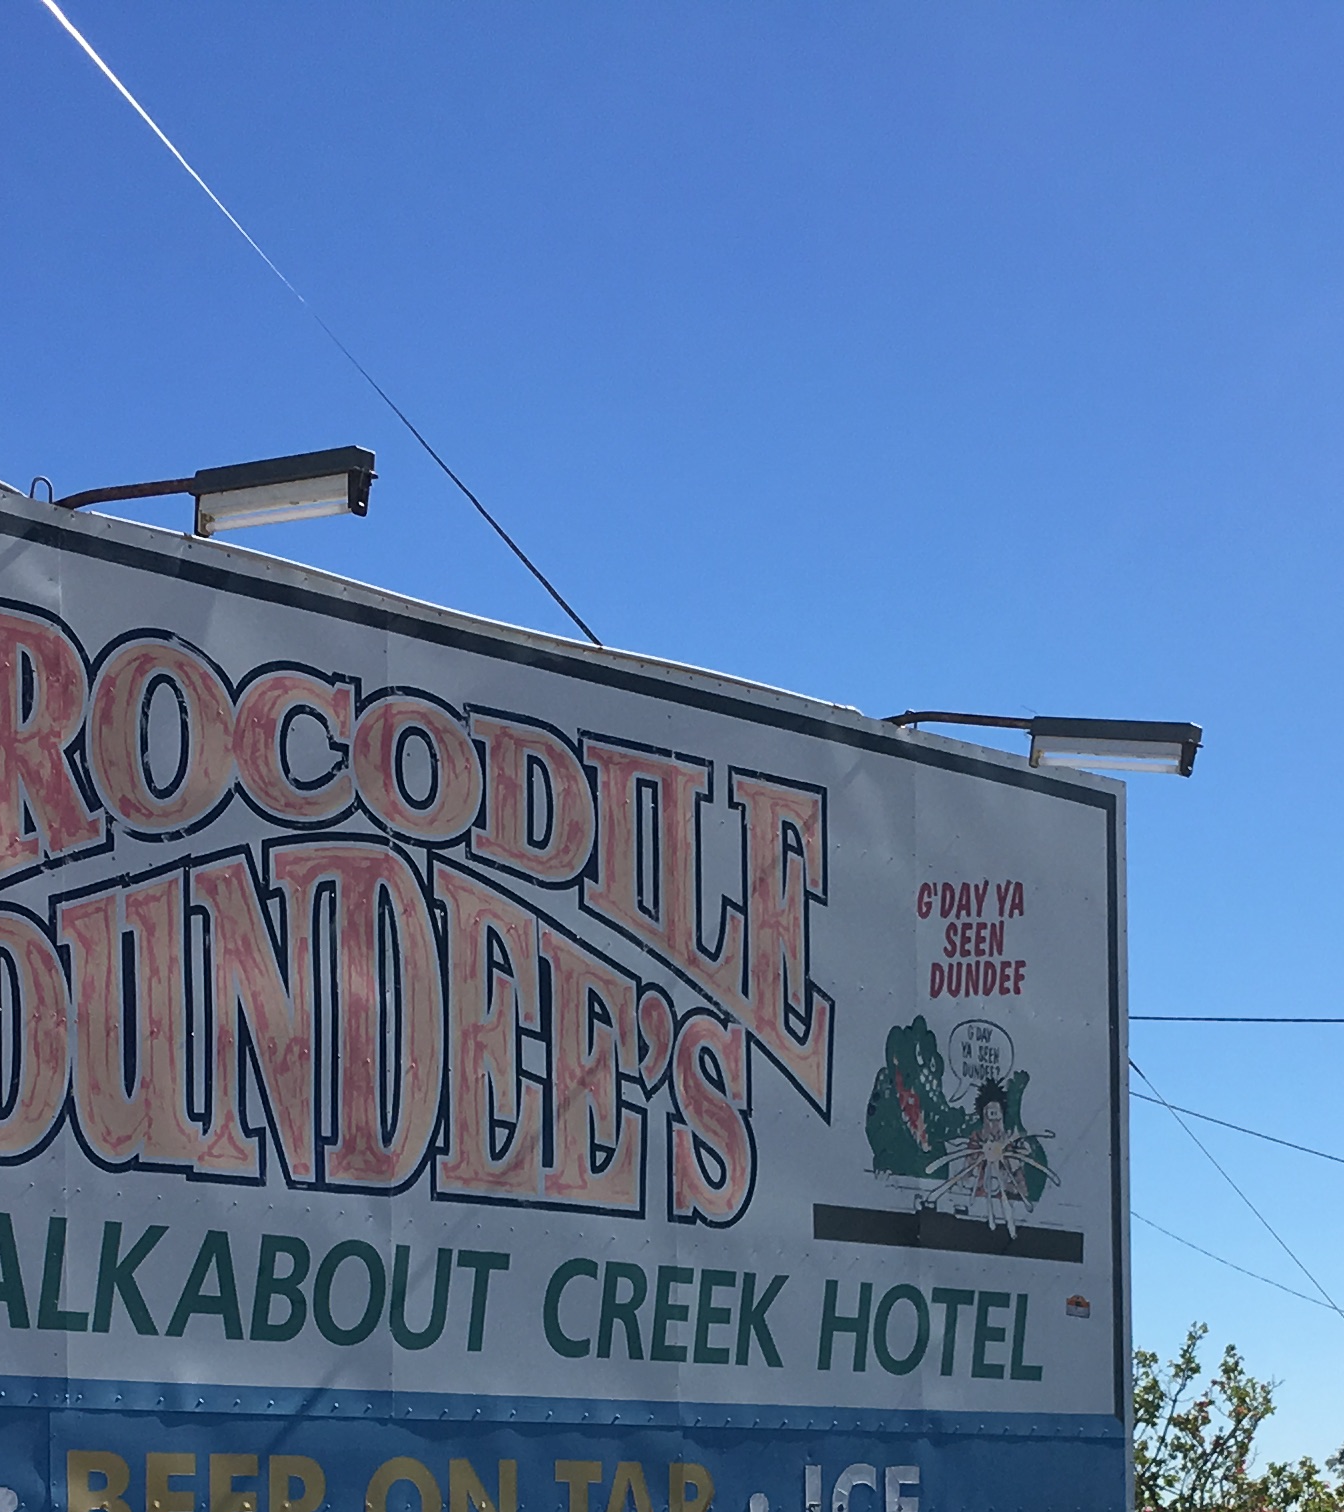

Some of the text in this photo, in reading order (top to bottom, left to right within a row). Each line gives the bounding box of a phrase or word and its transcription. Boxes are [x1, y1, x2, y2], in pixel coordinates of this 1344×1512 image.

[917, 879, 1024, 920] G'DAY YA
[943, 920, 1005, 959] SEEN
[543, 1258, 795, 1369] CREEK
[817, 1278, 1044, 1382] HOTEL
